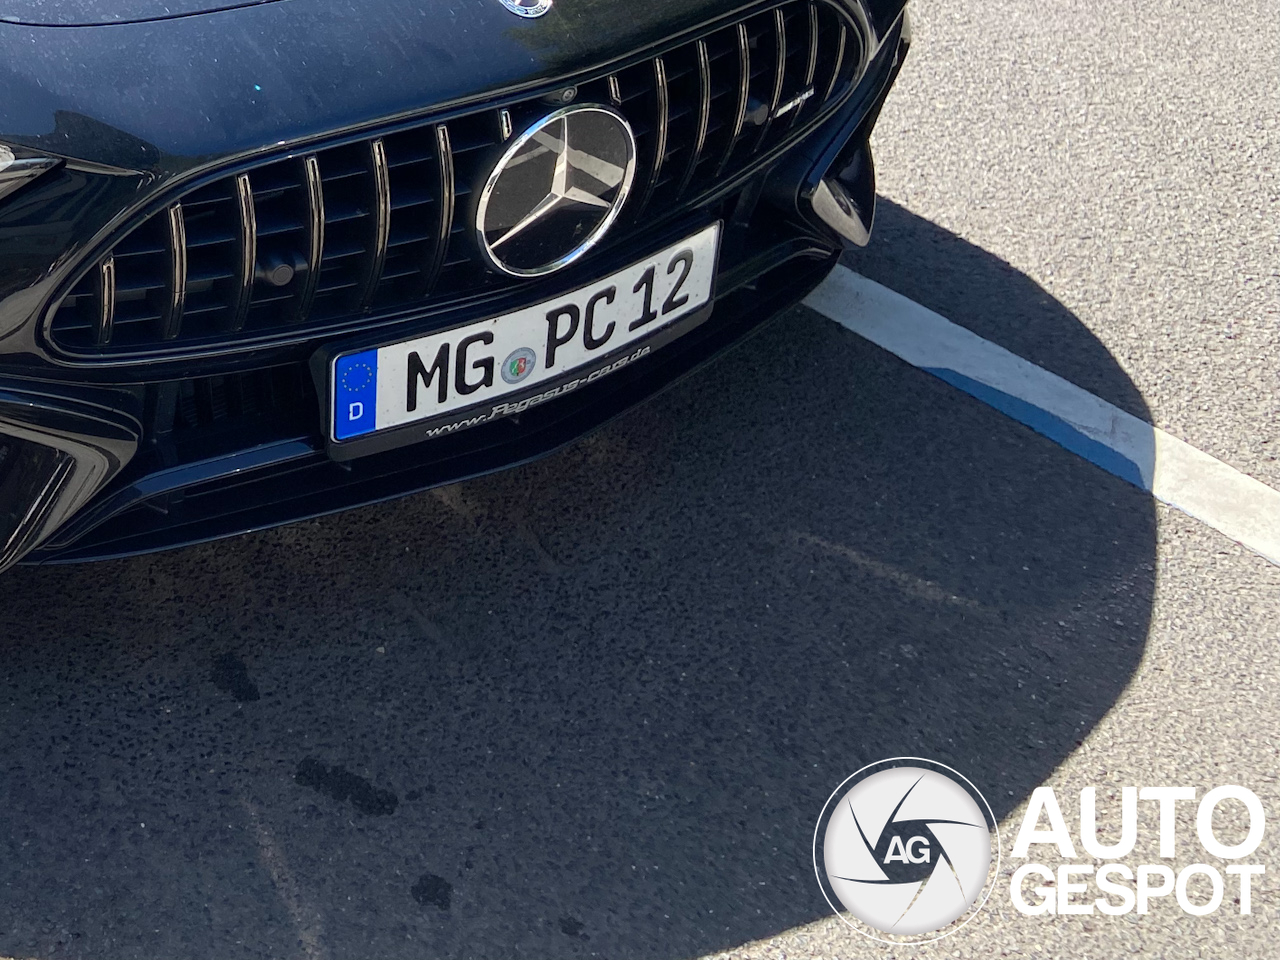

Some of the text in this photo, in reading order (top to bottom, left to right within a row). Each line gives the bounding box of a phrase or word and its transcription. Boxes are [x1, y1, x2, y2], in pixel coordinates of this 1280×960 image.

[349, 402, 363, 420] D
[406, 331, 495, 413] MG
[544, 284, 617, 369] PC
[628, 248, 693, 333] 12
[425, 344, 651, 437] www.Pegasus-cars.de
